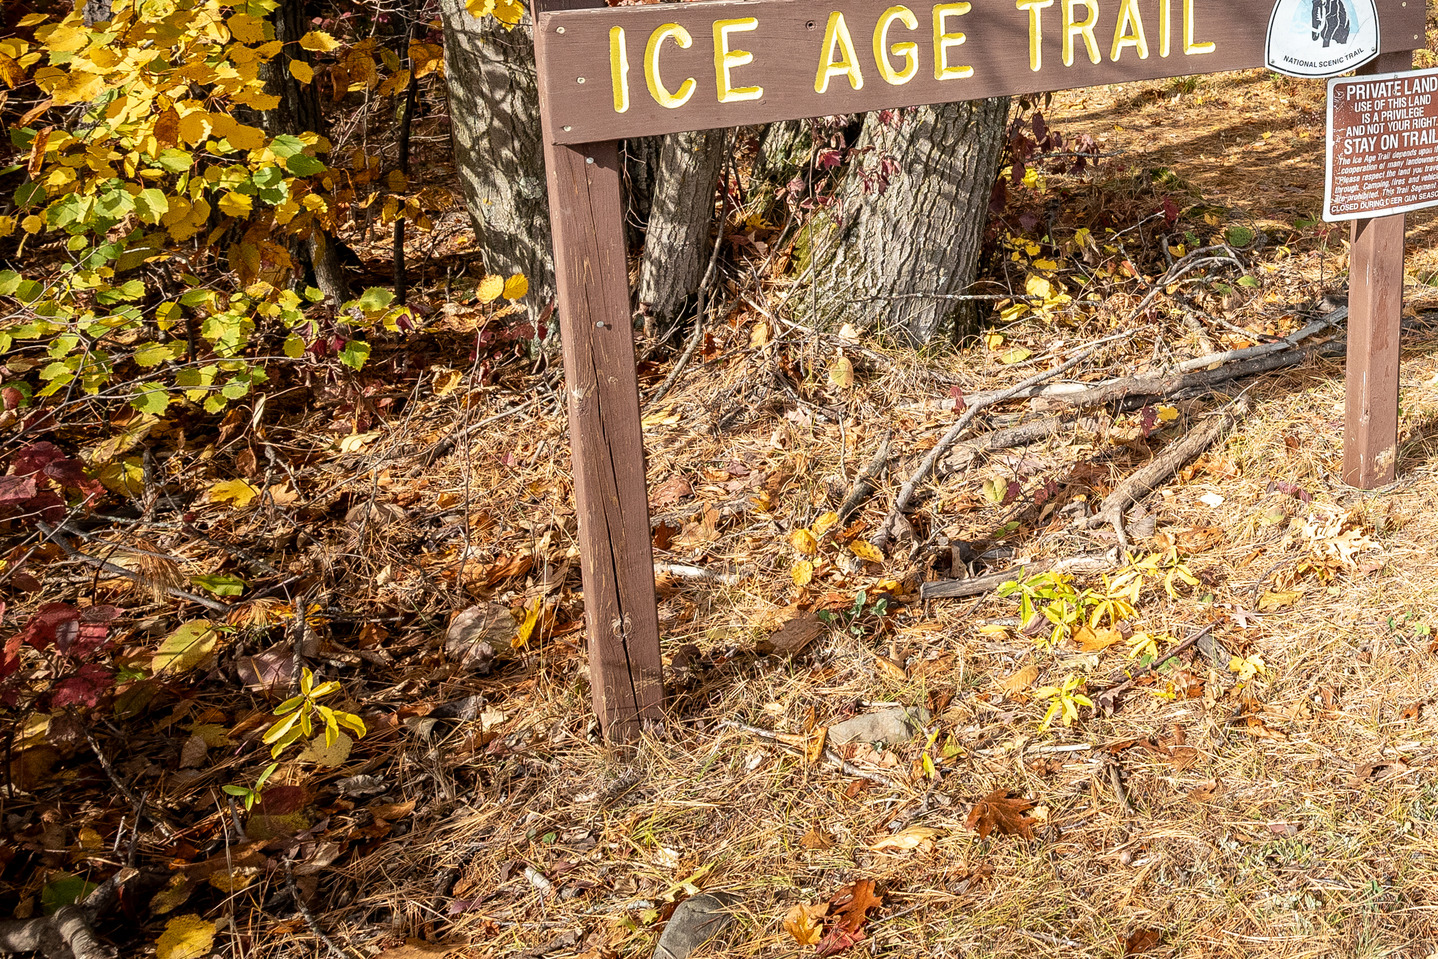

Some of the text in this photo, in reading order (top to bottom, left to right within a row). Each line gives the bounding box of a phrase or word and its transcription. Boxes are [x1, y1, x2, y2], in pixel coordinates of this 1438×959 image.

[609, 16, 764, 113] ICE
[814, 0, 975, 94] AGE
[1284, 48, 1364, 67] NATIONAL SCENIC TRAIL
[1347, 76, 1438, 100] PRIVATE LAND
[1355, 94, 1431, 112] USE OF THIS LAND
[1362, 107, 1424, 124] IS A PRIVILEGE
[1346, 116, 1438, 137] AND NOT YOUR RIGHT.
[1344, 128, 1438, 155] STAY ON TRAIL
[1364, 155, 1376, 163] Age
[1331, 204, 1358, 212] CLOSED
[1360, 199, 1384, 209] DURING
[1386, 197, 1402, 205] DEER
